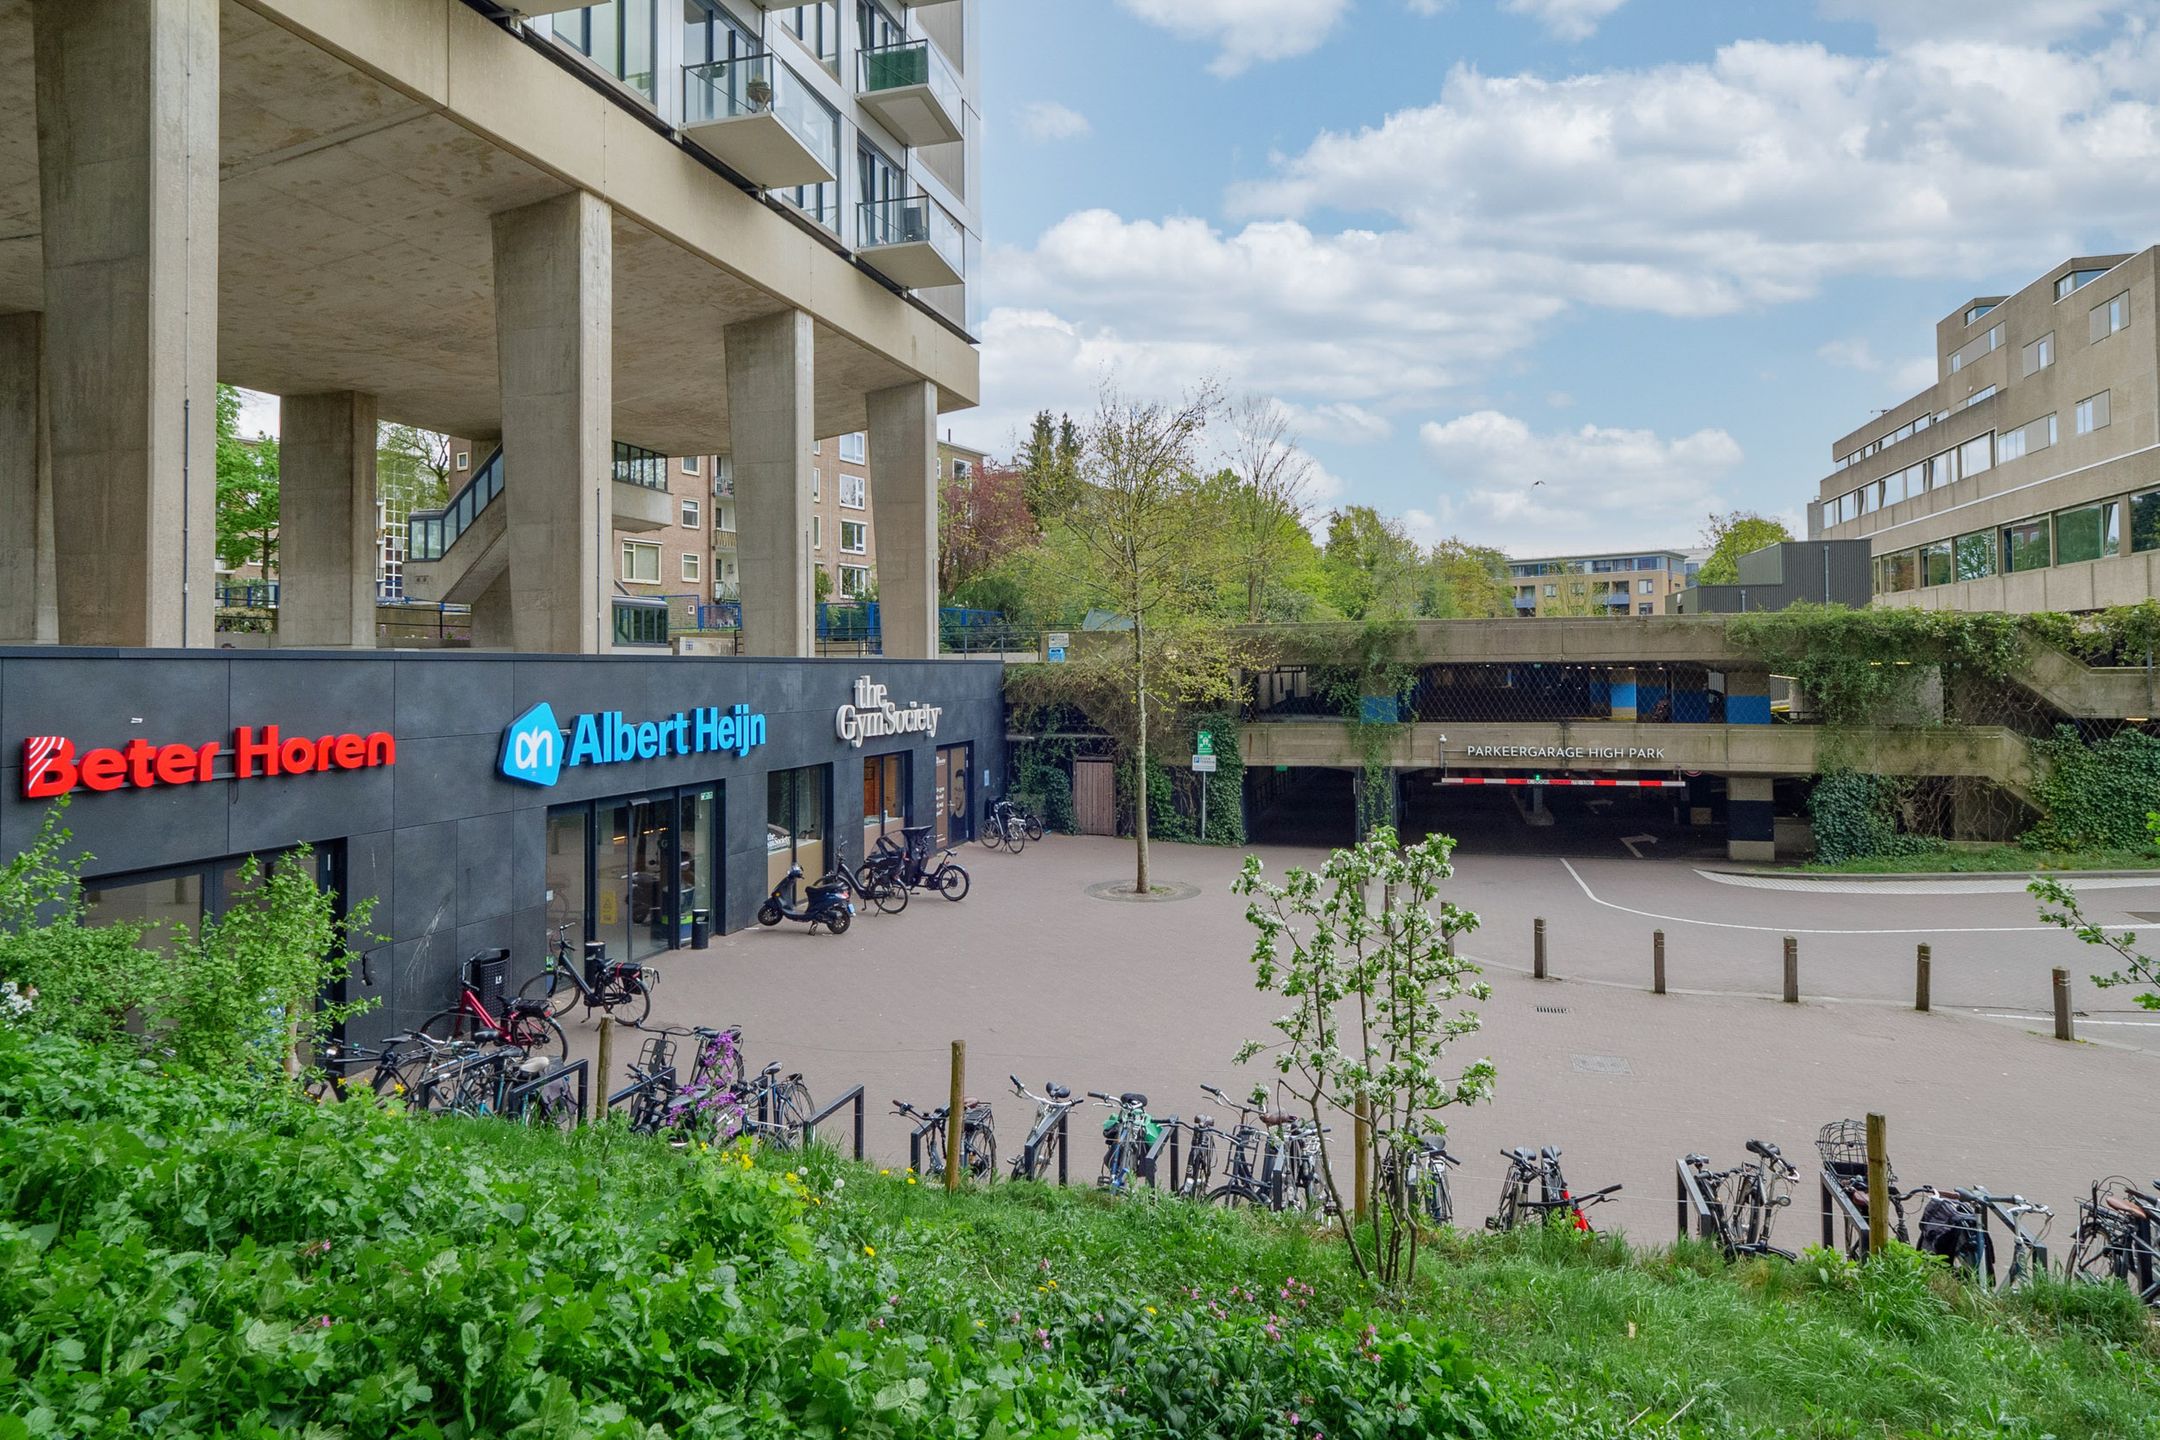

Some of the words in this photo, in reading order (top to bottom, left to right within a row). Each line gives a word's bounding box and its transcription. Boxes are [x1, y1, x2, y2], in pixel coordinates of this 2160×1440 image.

[854, 675, 887, 708] the
[569, 711, 690, 767] Albert
[693, 704, 766, 757] Heijn
[836, 702, 942, 748] GymSociety
[24, 736, 220, 798] Beter
[235, 725, 396, 778] Horen
[1467, 746, 1583, 758] PARKEERGARAGE
[1589, 748, 1624, 758] HIGH
[1629, 748, 1665, 759] PARK
